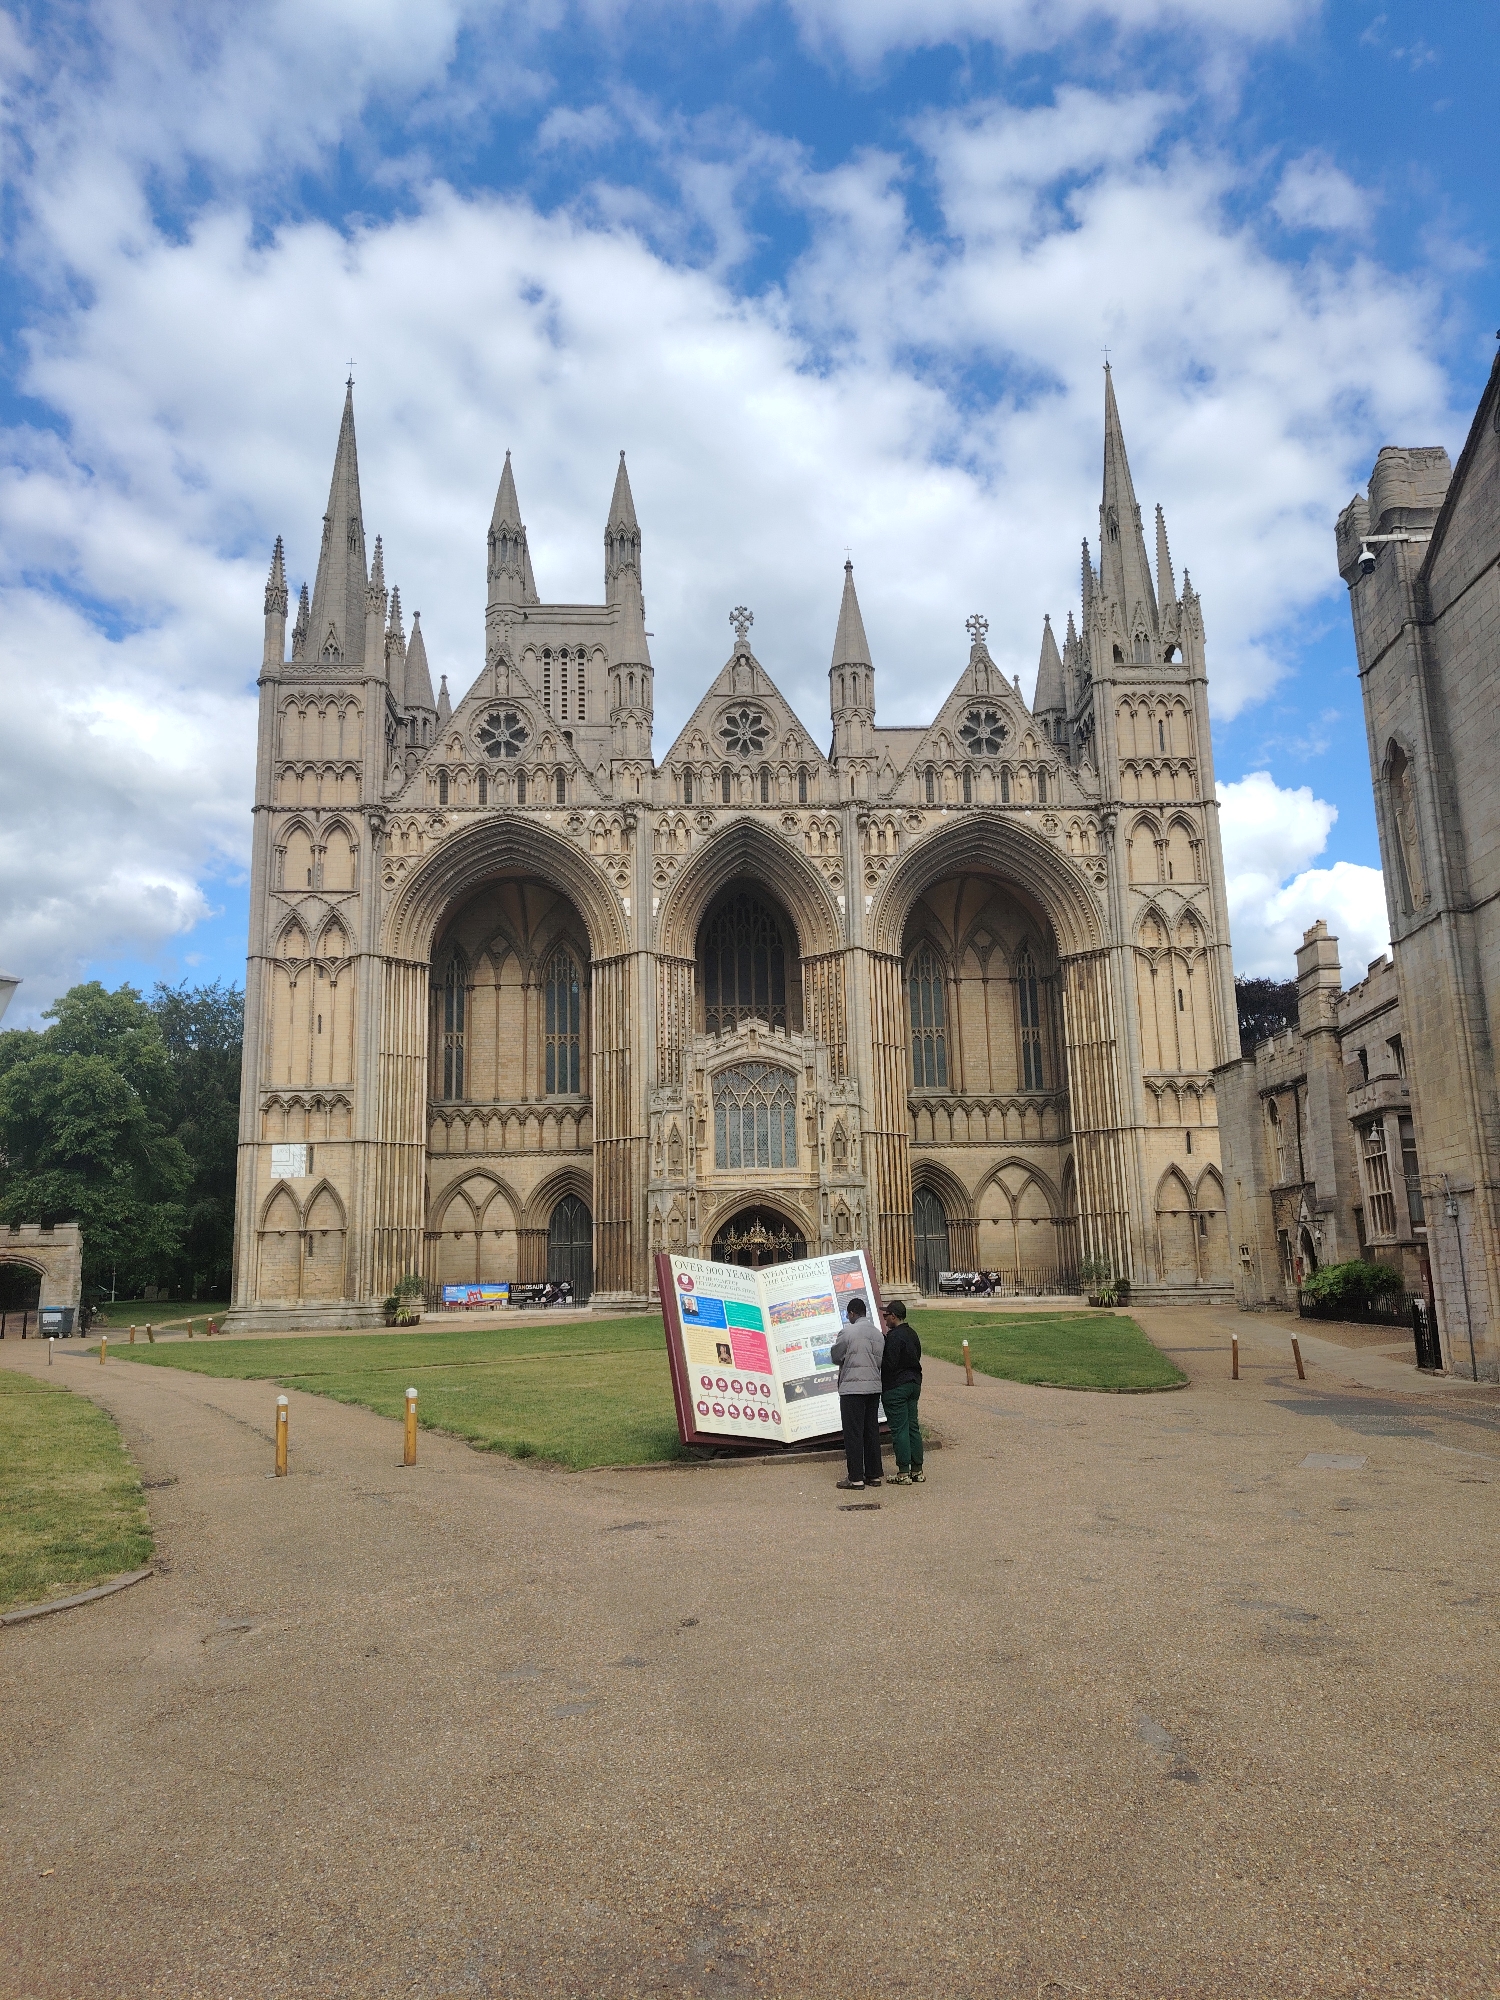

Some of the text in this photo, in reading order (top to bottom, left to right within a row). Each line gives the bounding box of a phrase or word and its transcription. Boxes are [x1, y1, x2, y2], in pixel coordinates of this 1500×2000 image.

[675, 1260, 756, 1283] OVER 900 YEARS
[762, 1266, 797, 1280] WHAT'S
[797, 1263, 812, 1271] ON
[763, 1269, 828, 1287] THE CATHEDRAL
